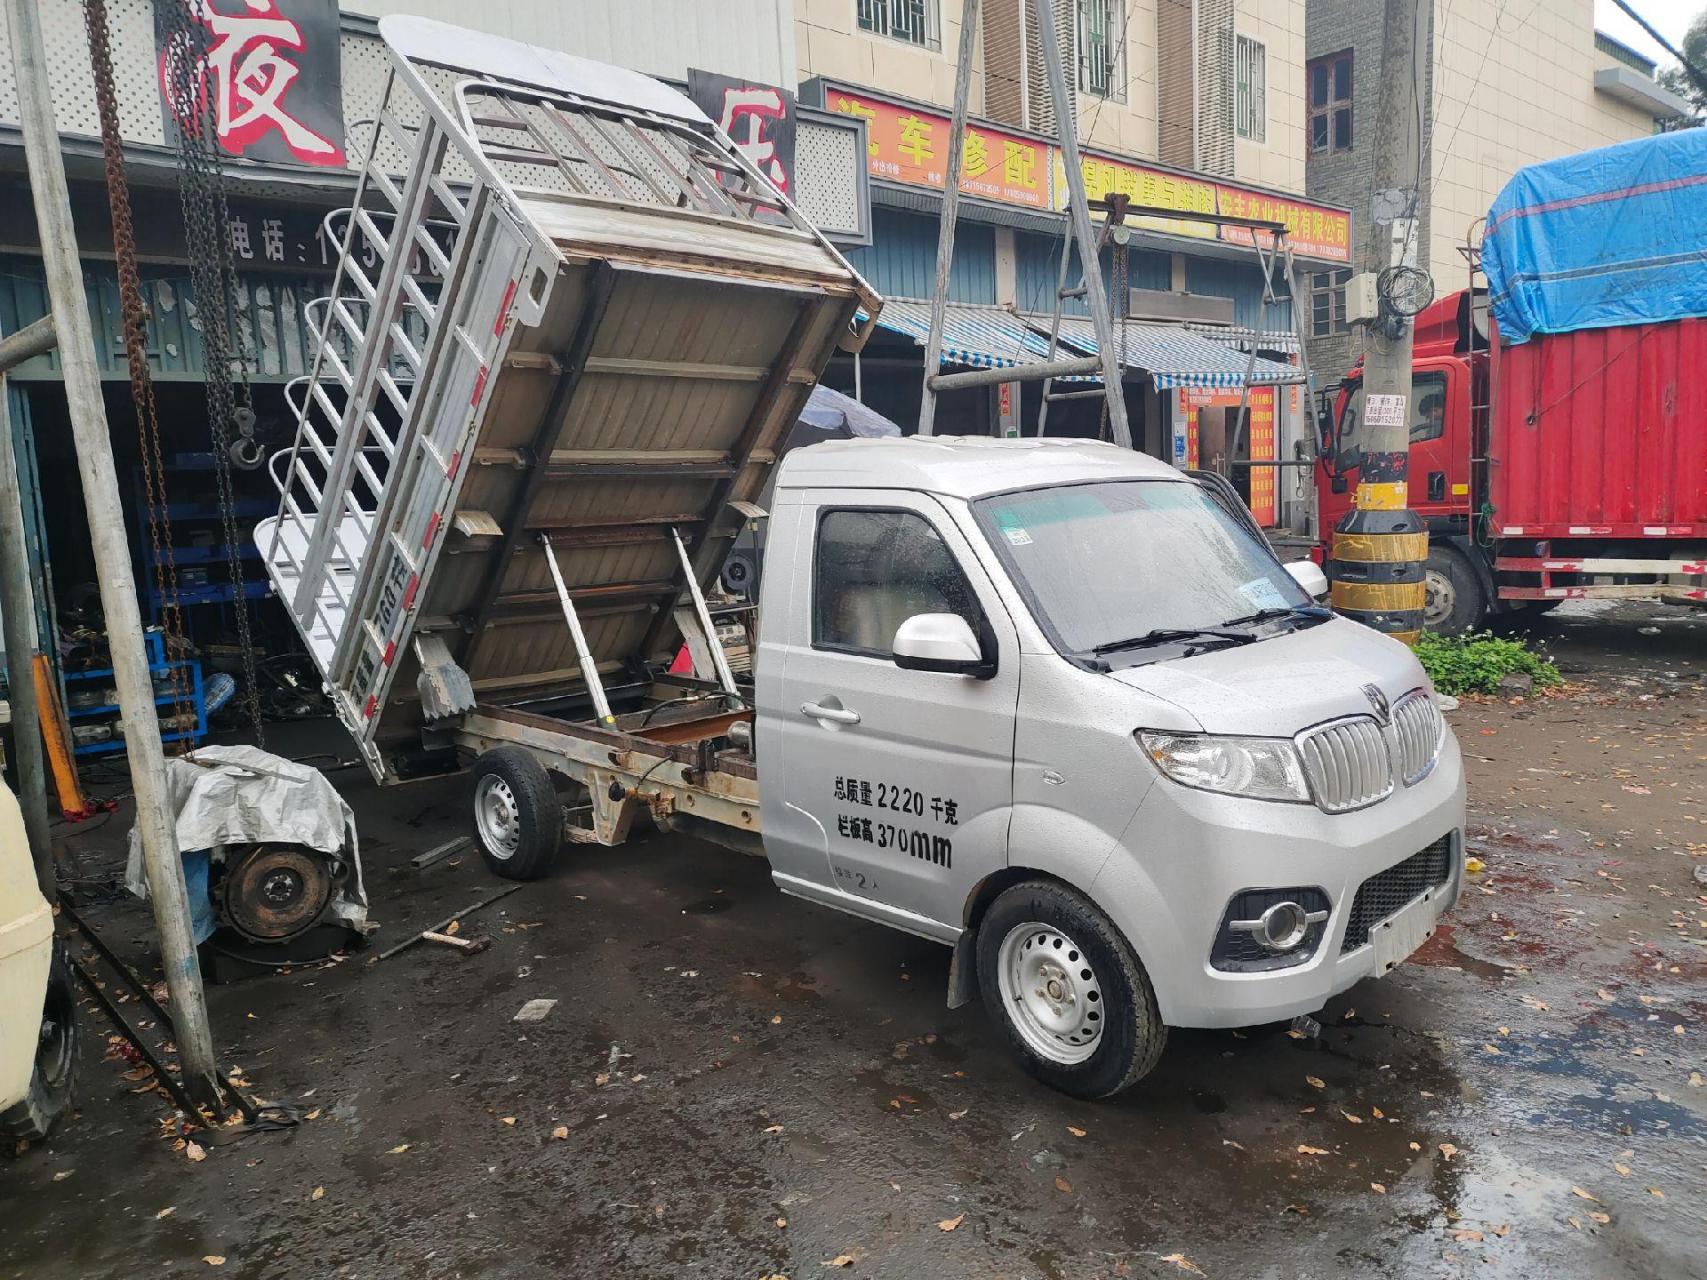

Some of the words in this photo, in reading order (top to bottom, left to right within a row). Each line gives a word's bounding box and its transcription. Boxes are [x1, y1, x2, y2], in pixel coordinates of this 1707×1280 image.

[838, 96, 1038, 189] 汽车修配
[834, 776, 958, 825] 总质量2220千克
[838, 813, 952, 869] 栏板高370mm
